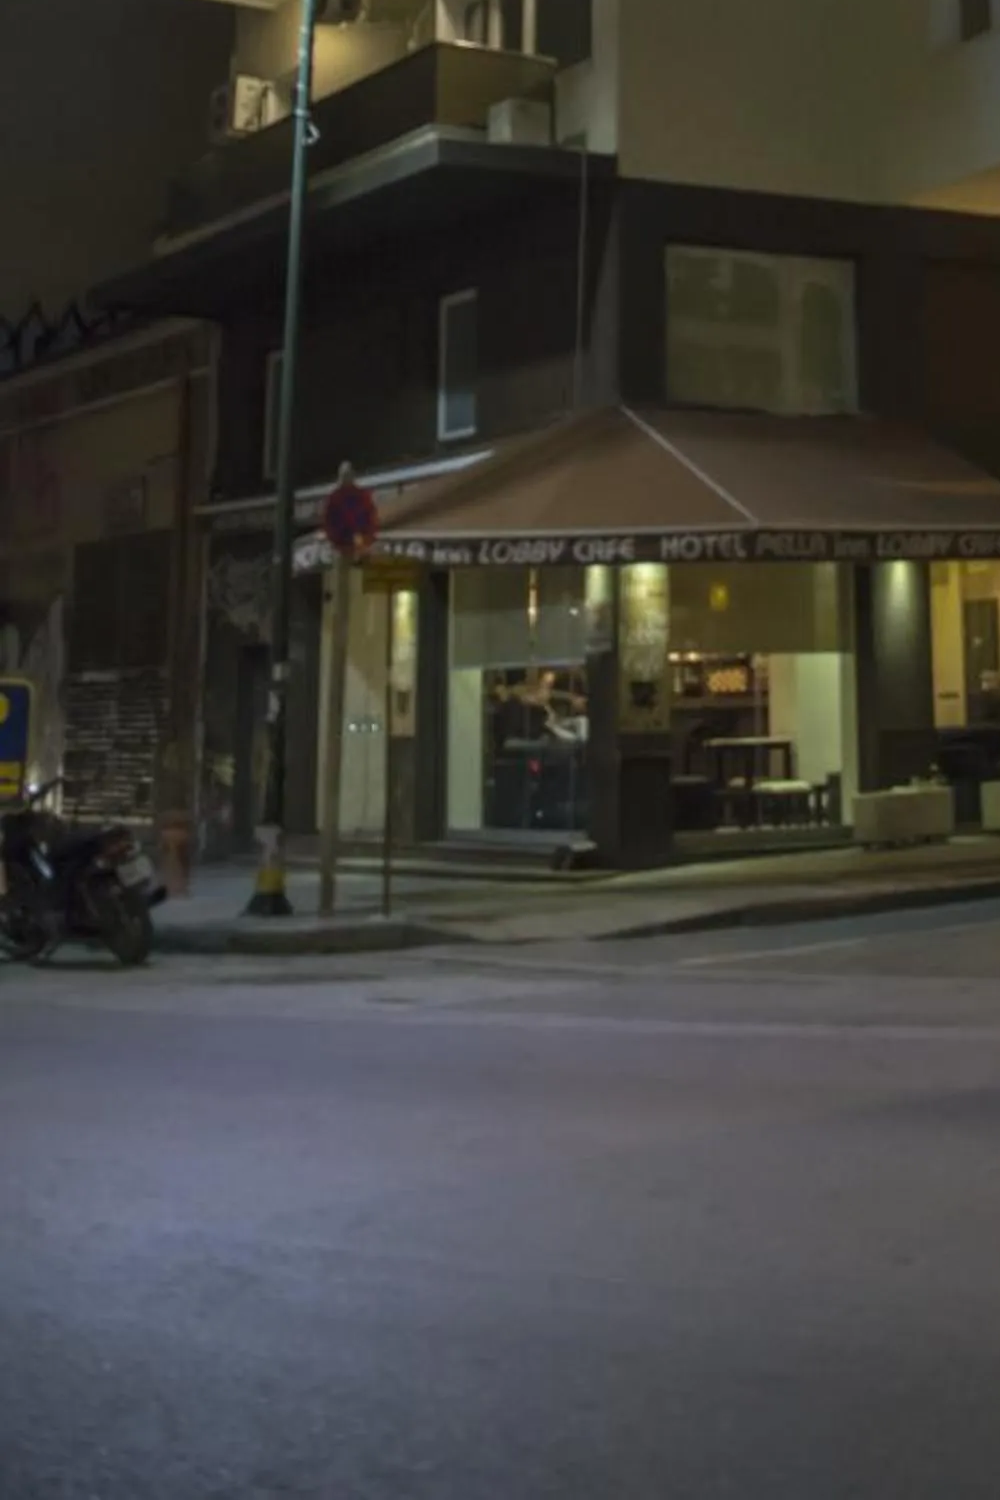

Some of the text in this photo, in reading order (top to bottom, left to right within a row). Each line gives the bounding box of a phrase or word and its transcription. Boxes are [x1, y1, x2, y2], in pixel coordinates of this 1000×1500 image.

[477, 539, 564, 565] LOBBY
[572, 534, 635, 563] CAFE
[660, 533, 748, 560] HOTEL
[754, 532, 828, 559] PELLA
